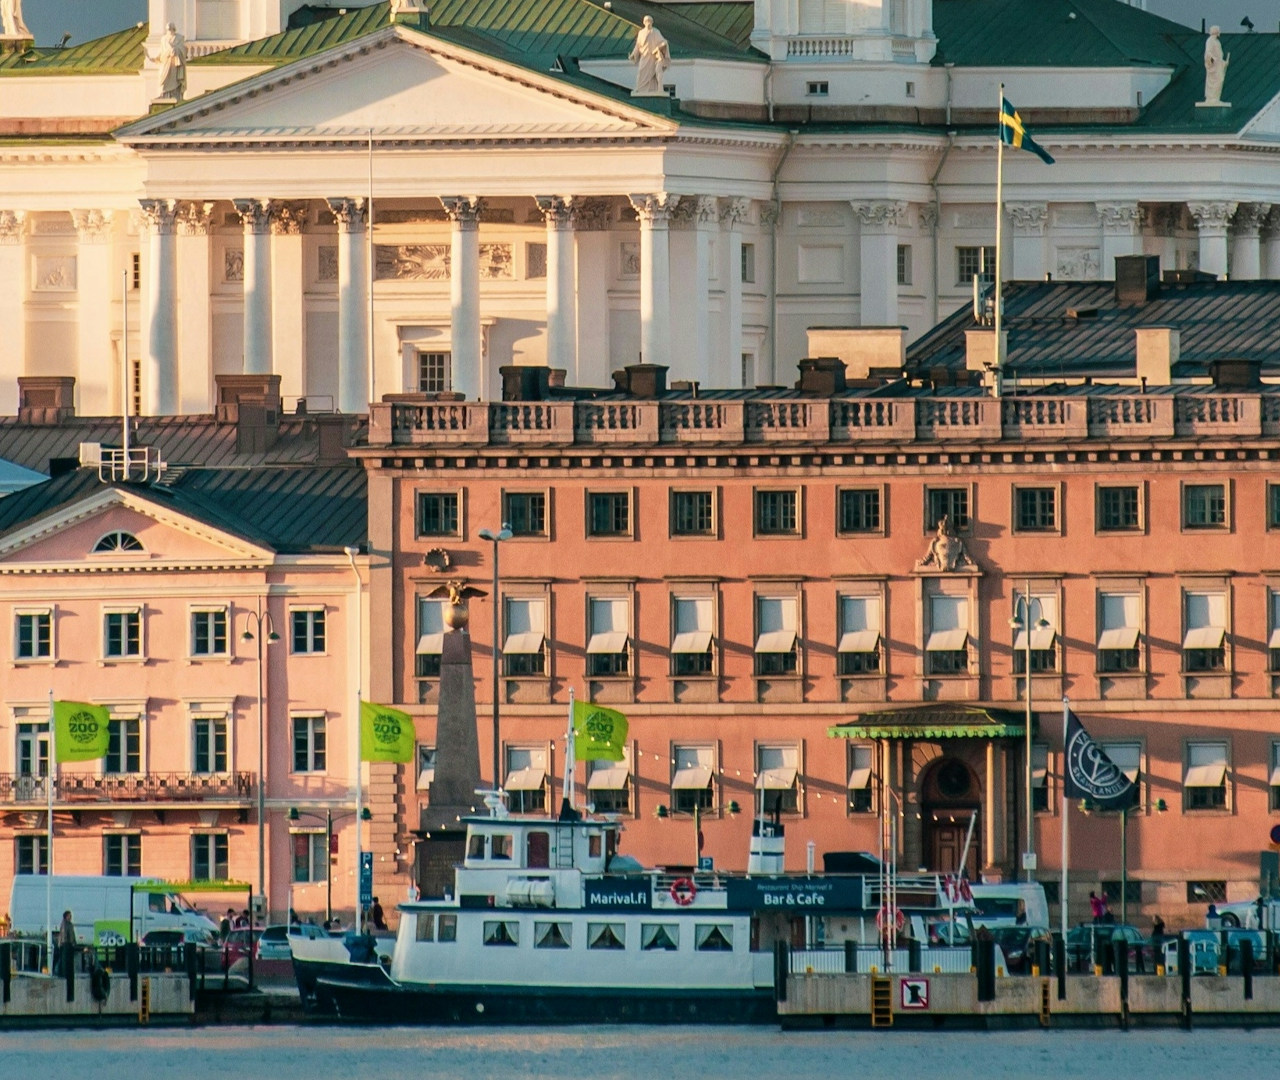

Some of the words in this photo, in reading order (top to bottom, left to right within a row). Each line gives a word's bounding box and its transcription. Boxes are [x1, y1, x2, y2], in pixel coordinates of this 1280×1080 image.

[69, 723, 99, 733] ZOO
[374, 724, 401, 735] ZOO
[587, 723, 614, 734] ZOO
[363, 853, 371, 863] P
[702, 859, 711, 869] P
[791, 884, 804, 892] Ship
[590, 892, 647, 905] Marival.fi
[764, 893, 785, 905] Bar
[786, 893, 795, 905] &
[796, 893, 825, 905] Cafe
[100, 936, 126, 947] ZOO
